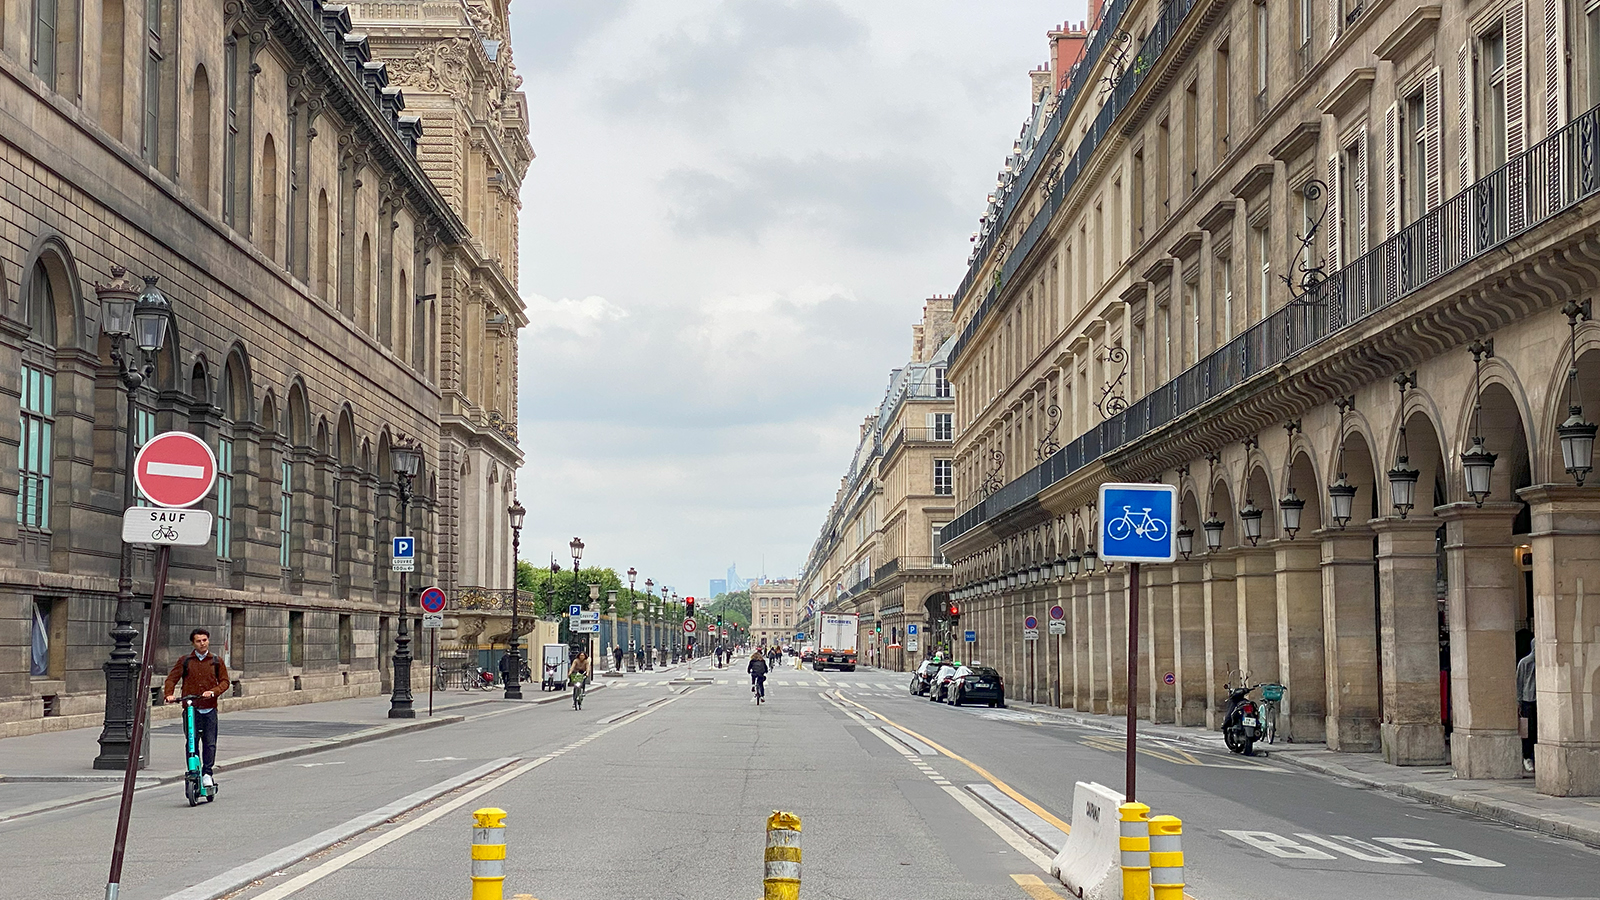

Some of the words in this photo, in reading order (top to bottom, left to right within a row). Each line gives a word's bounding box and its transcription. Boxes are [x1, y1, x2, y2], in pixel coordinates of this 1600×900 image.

[150, 511, 186, 523] SAUF
[399, 541, 408, 554] P
[1218, 829, 1507, 867] BUS
